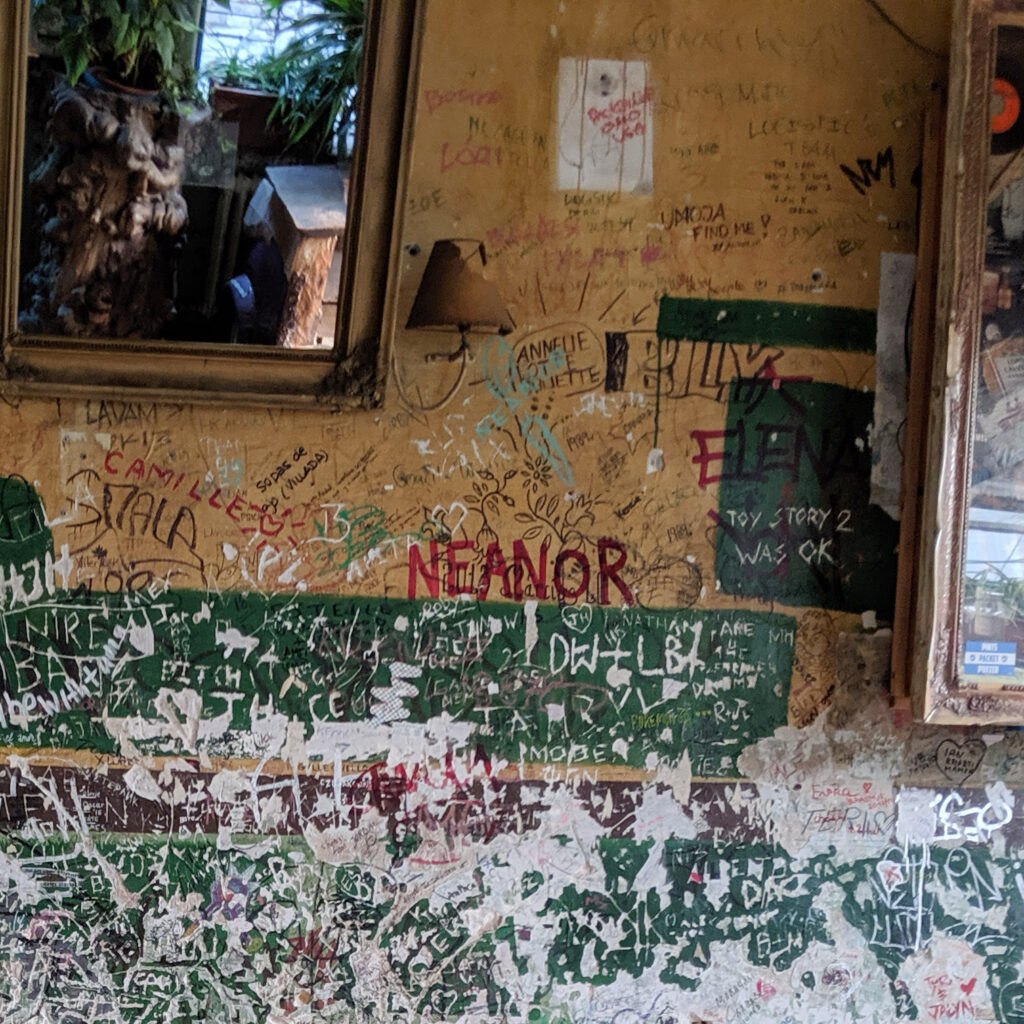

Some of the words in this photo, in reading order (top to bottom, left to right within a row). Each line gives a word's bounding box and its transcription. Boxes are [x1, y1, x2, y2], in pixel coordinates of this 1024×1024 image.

[692, 223, 729, 243] FIND
[727, 510, 762, 527] TOY
[769, 507, 831, 527] STORY
[837, 509, 855, 533] 2
[735, 543, 787, 567] WAS
[798, 539, 836, 565] OK
[407, 538, 634, 607] NEANOR
